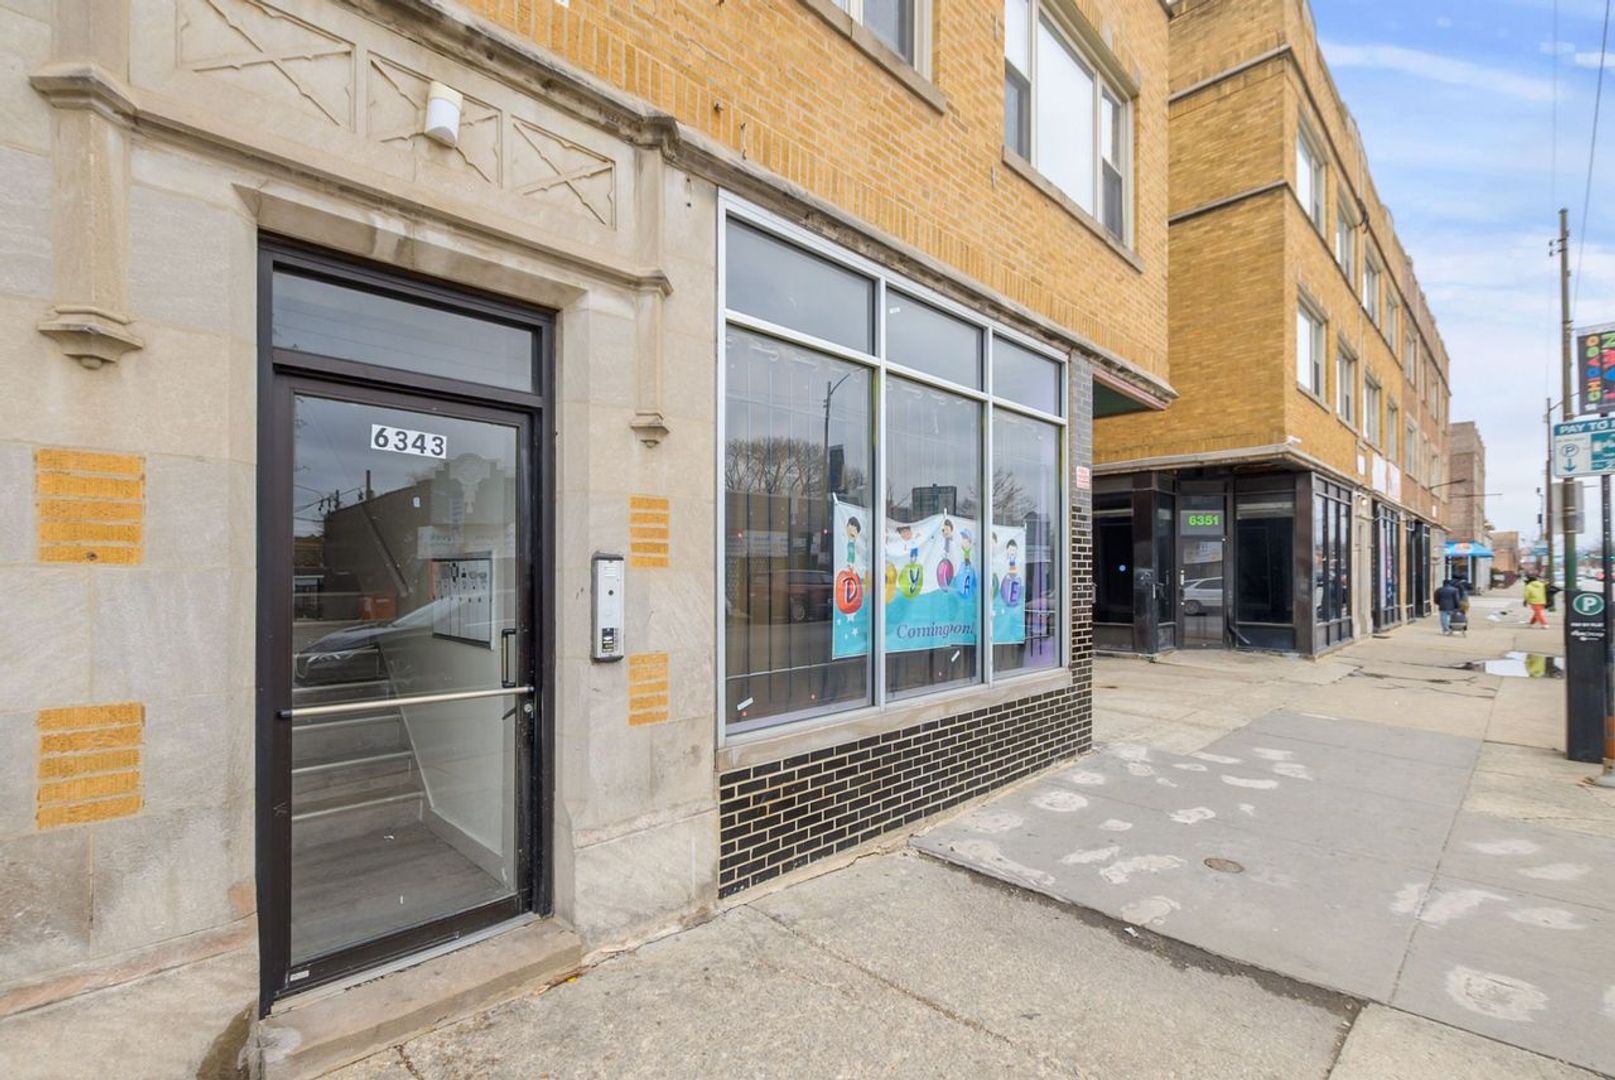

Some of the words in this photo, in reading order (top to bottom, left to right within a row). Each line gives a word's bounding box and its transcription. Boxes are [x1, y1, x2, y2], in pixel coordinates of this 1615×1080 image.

[1559, 423, 1585, 434] PAY
[1590, 419, 1609, 430] TO
[374, 427, 444, 456] 6343
[1188, 514, 1219, 526] 6351
[1582, 596, 1597, 612] P
